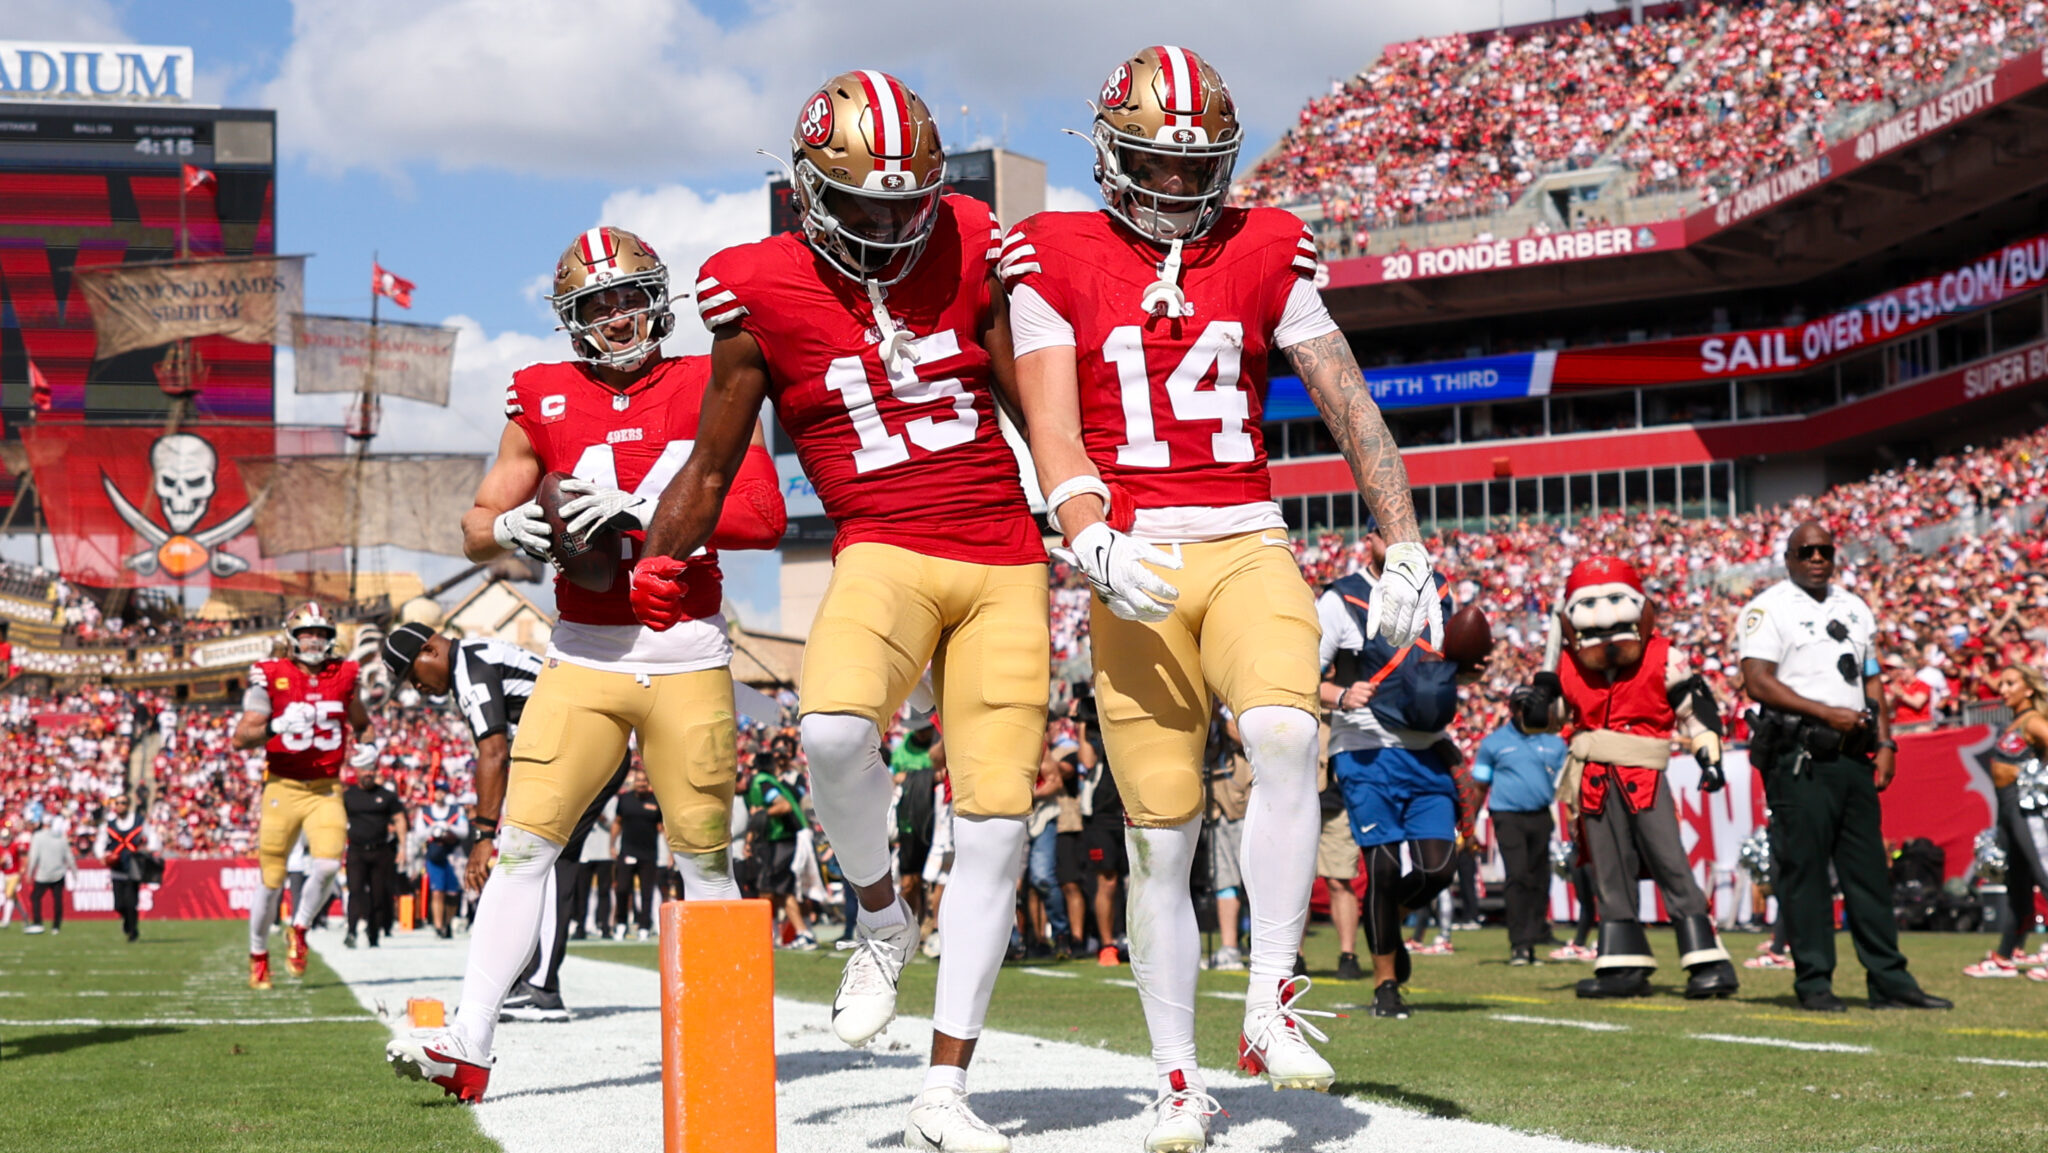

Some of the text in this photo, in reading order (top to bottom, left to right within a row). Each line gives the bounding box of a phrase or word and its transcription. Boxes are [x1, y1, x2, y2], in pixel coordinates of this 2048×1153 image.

[1876, 113, 1918, 154] MIKE
[1919, 73, 1996, 135] ALSTOTT
[134, 138, 195, 156] 4:15
[1732, 185, 1770, 221] JOHN
[1770, 157, 1820, 201] LYNCH
[1381, 227, 1633, 281] 20 RONDÉ BARBER
[213, 276, 287, 298] JAMES
[1701, 238, 2048, 373] SAIL OVER TO 53.COM/BU
[824, 328, 979, 475] 15
[1102, 320, 1256, 468] 14
[1430, 369, 1499, 393] THIRD
[1963, 355, 2026, 399] SUPER
[541, 394, 567, 417] C
[605, 427, 644, 445] 49ERS
